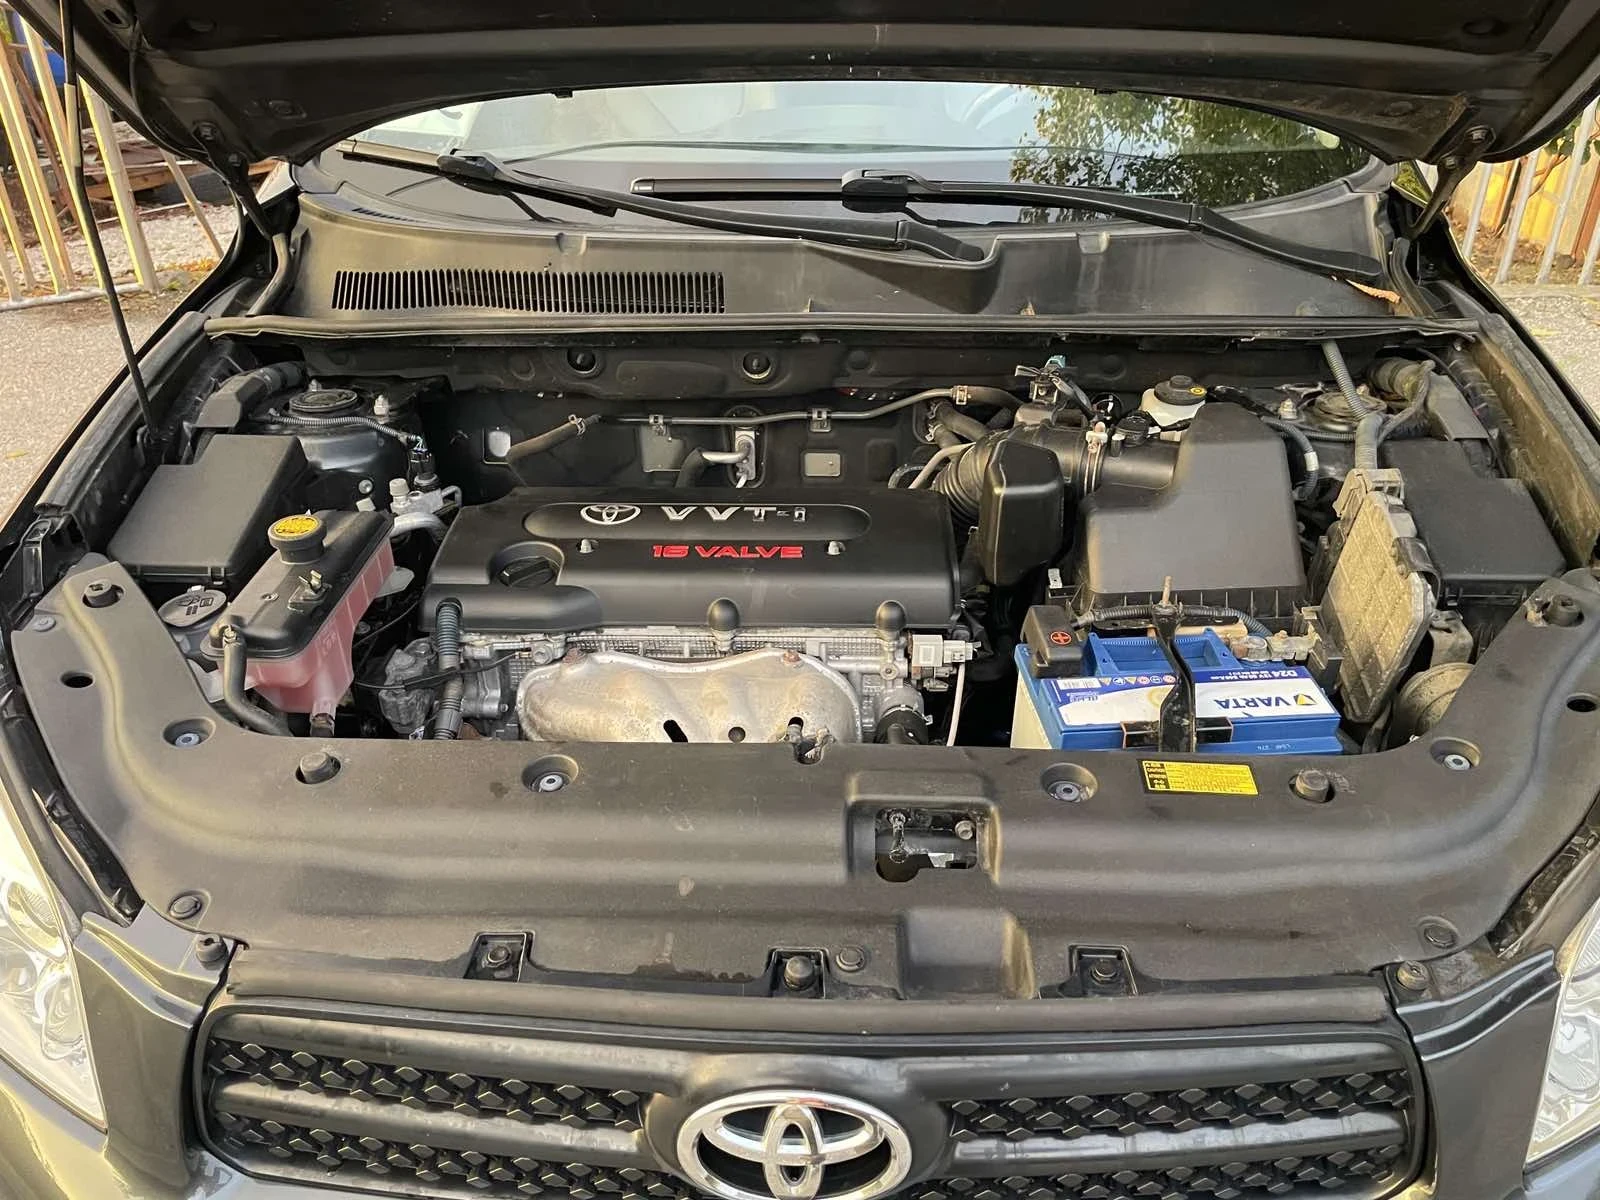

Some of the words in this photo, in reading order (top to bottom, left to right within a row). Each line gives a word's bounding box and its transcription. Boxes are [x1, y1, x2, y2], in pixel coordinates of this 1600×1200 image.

[660, 505, 807, 522] VVT-i
[653, 545, 690, 559] 16
[694, 545, 803, 559] VALVE
[1271, 669, 1298, 677] D24
[1213, 696, 1291, 709] VARTA
